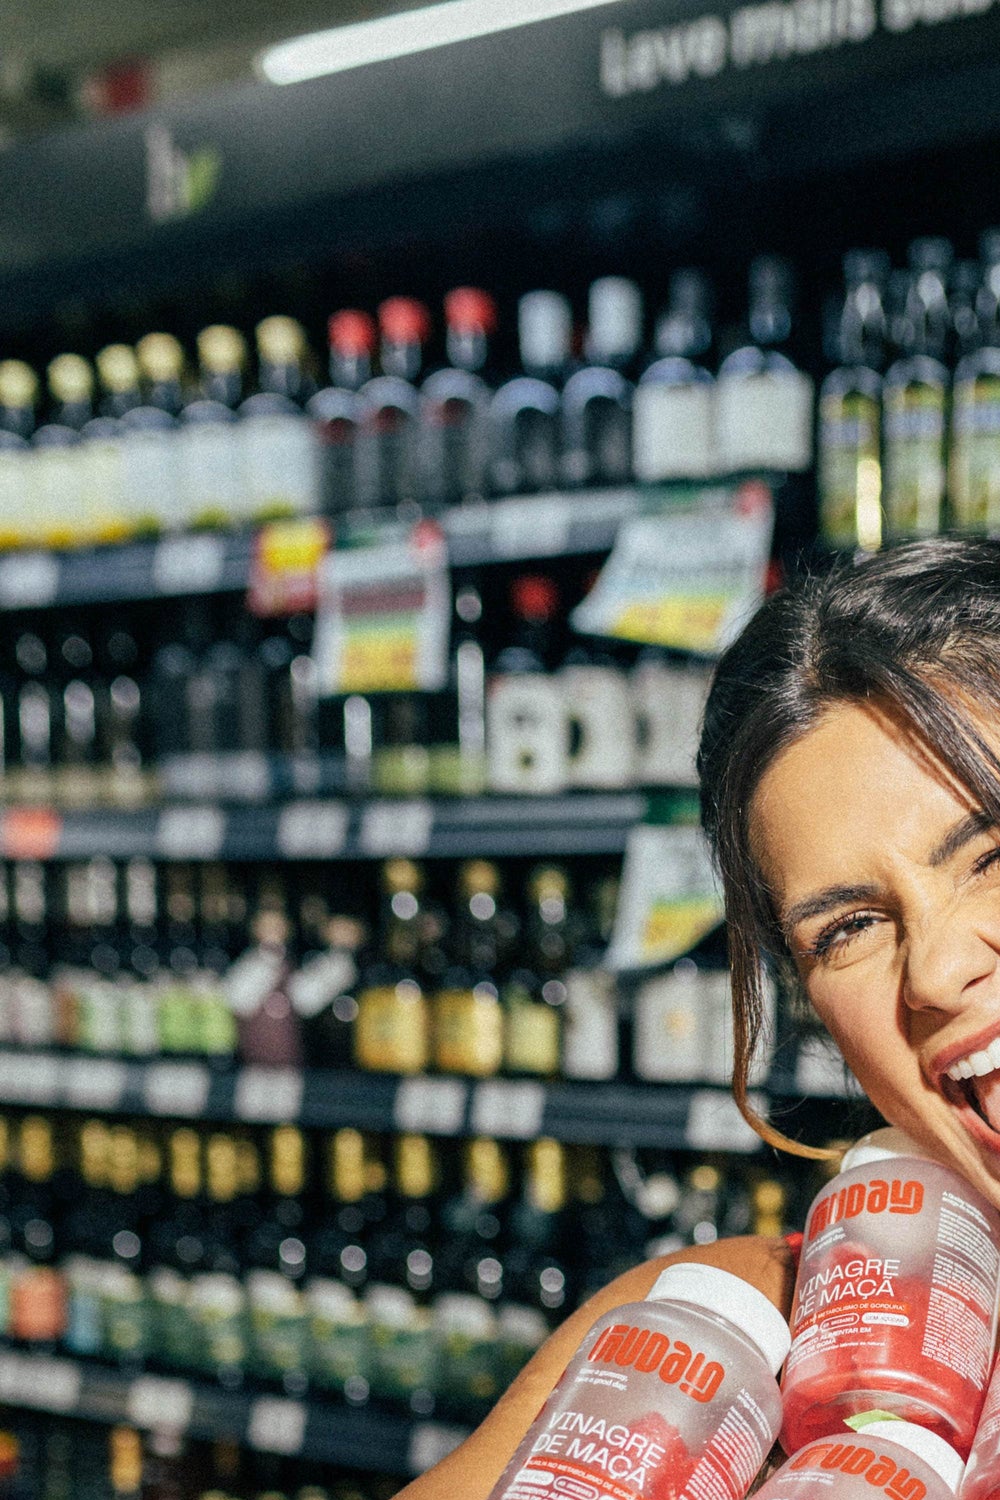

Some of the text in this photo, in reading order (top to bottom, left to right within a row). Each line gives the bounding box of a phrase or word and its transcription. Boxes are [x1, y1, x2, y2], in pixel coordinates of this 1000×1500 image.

[793, 1276, 895, 1326] DE MAÇÃ
[798, 1258, 901, 1299] VINAGRE
[531, 1433, 566, 1454] DE
[565, 1438, 658, 1490] MAÇÃ
[549, 1411, 666, 1465] VINAGRE
